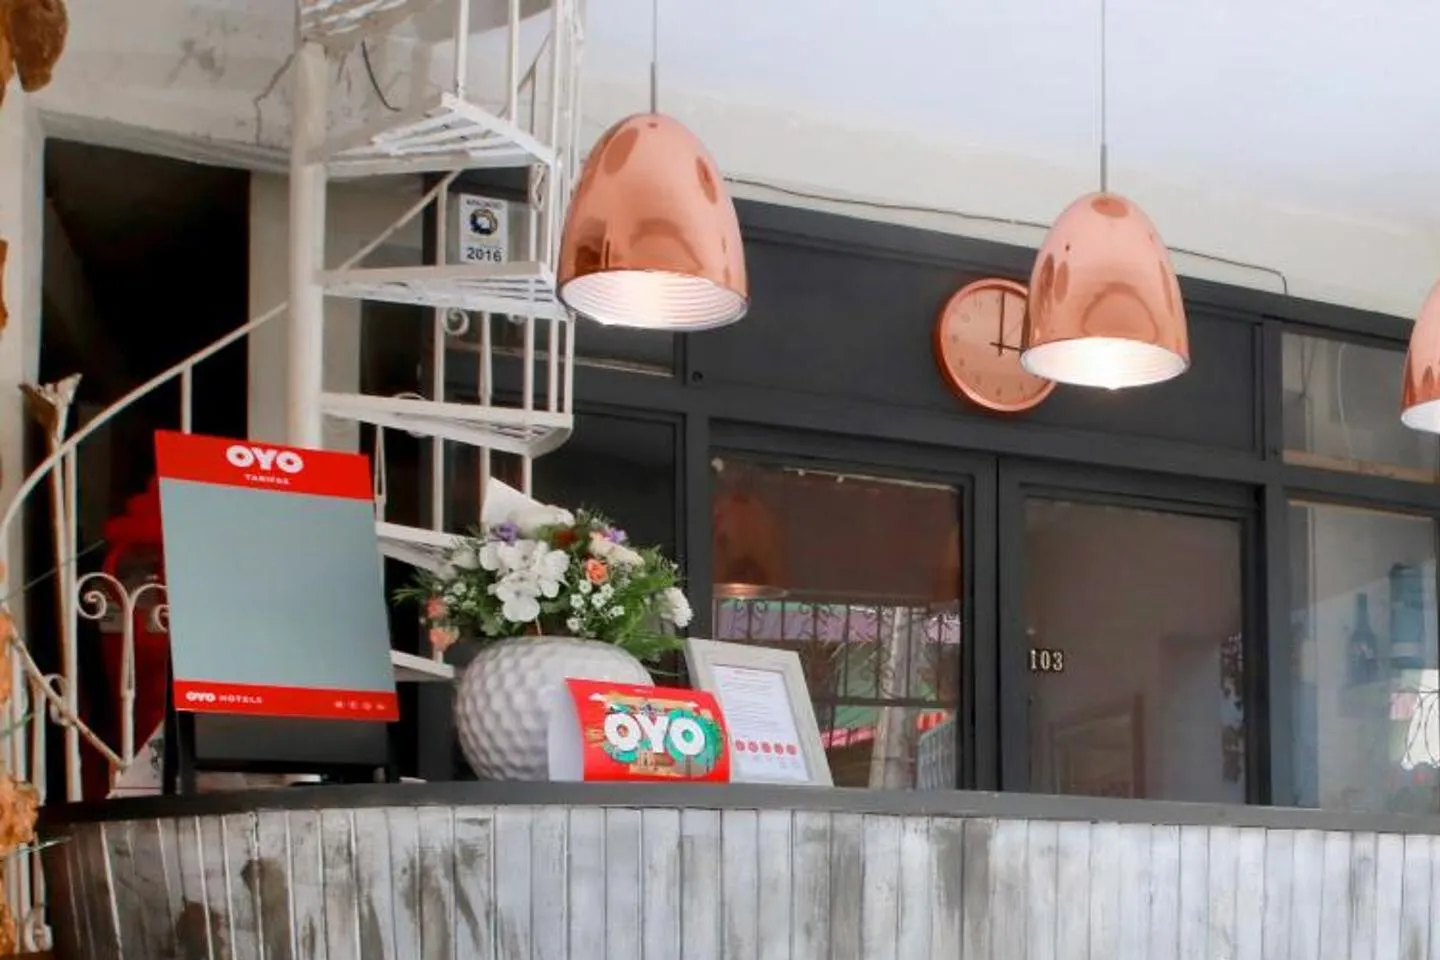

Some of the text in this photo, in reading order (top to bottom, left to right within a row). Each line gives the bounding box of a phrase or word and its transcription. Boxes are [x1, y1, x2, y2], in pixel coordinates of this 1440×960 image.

[467, 246, 502, 262] 2016
[226, 445, 304, 474] OYO
[1030, 649, 1063, 671] 103
[185, 691, 263, 704] OYO HOTELS
[603, 711, 706, 756] OYO
